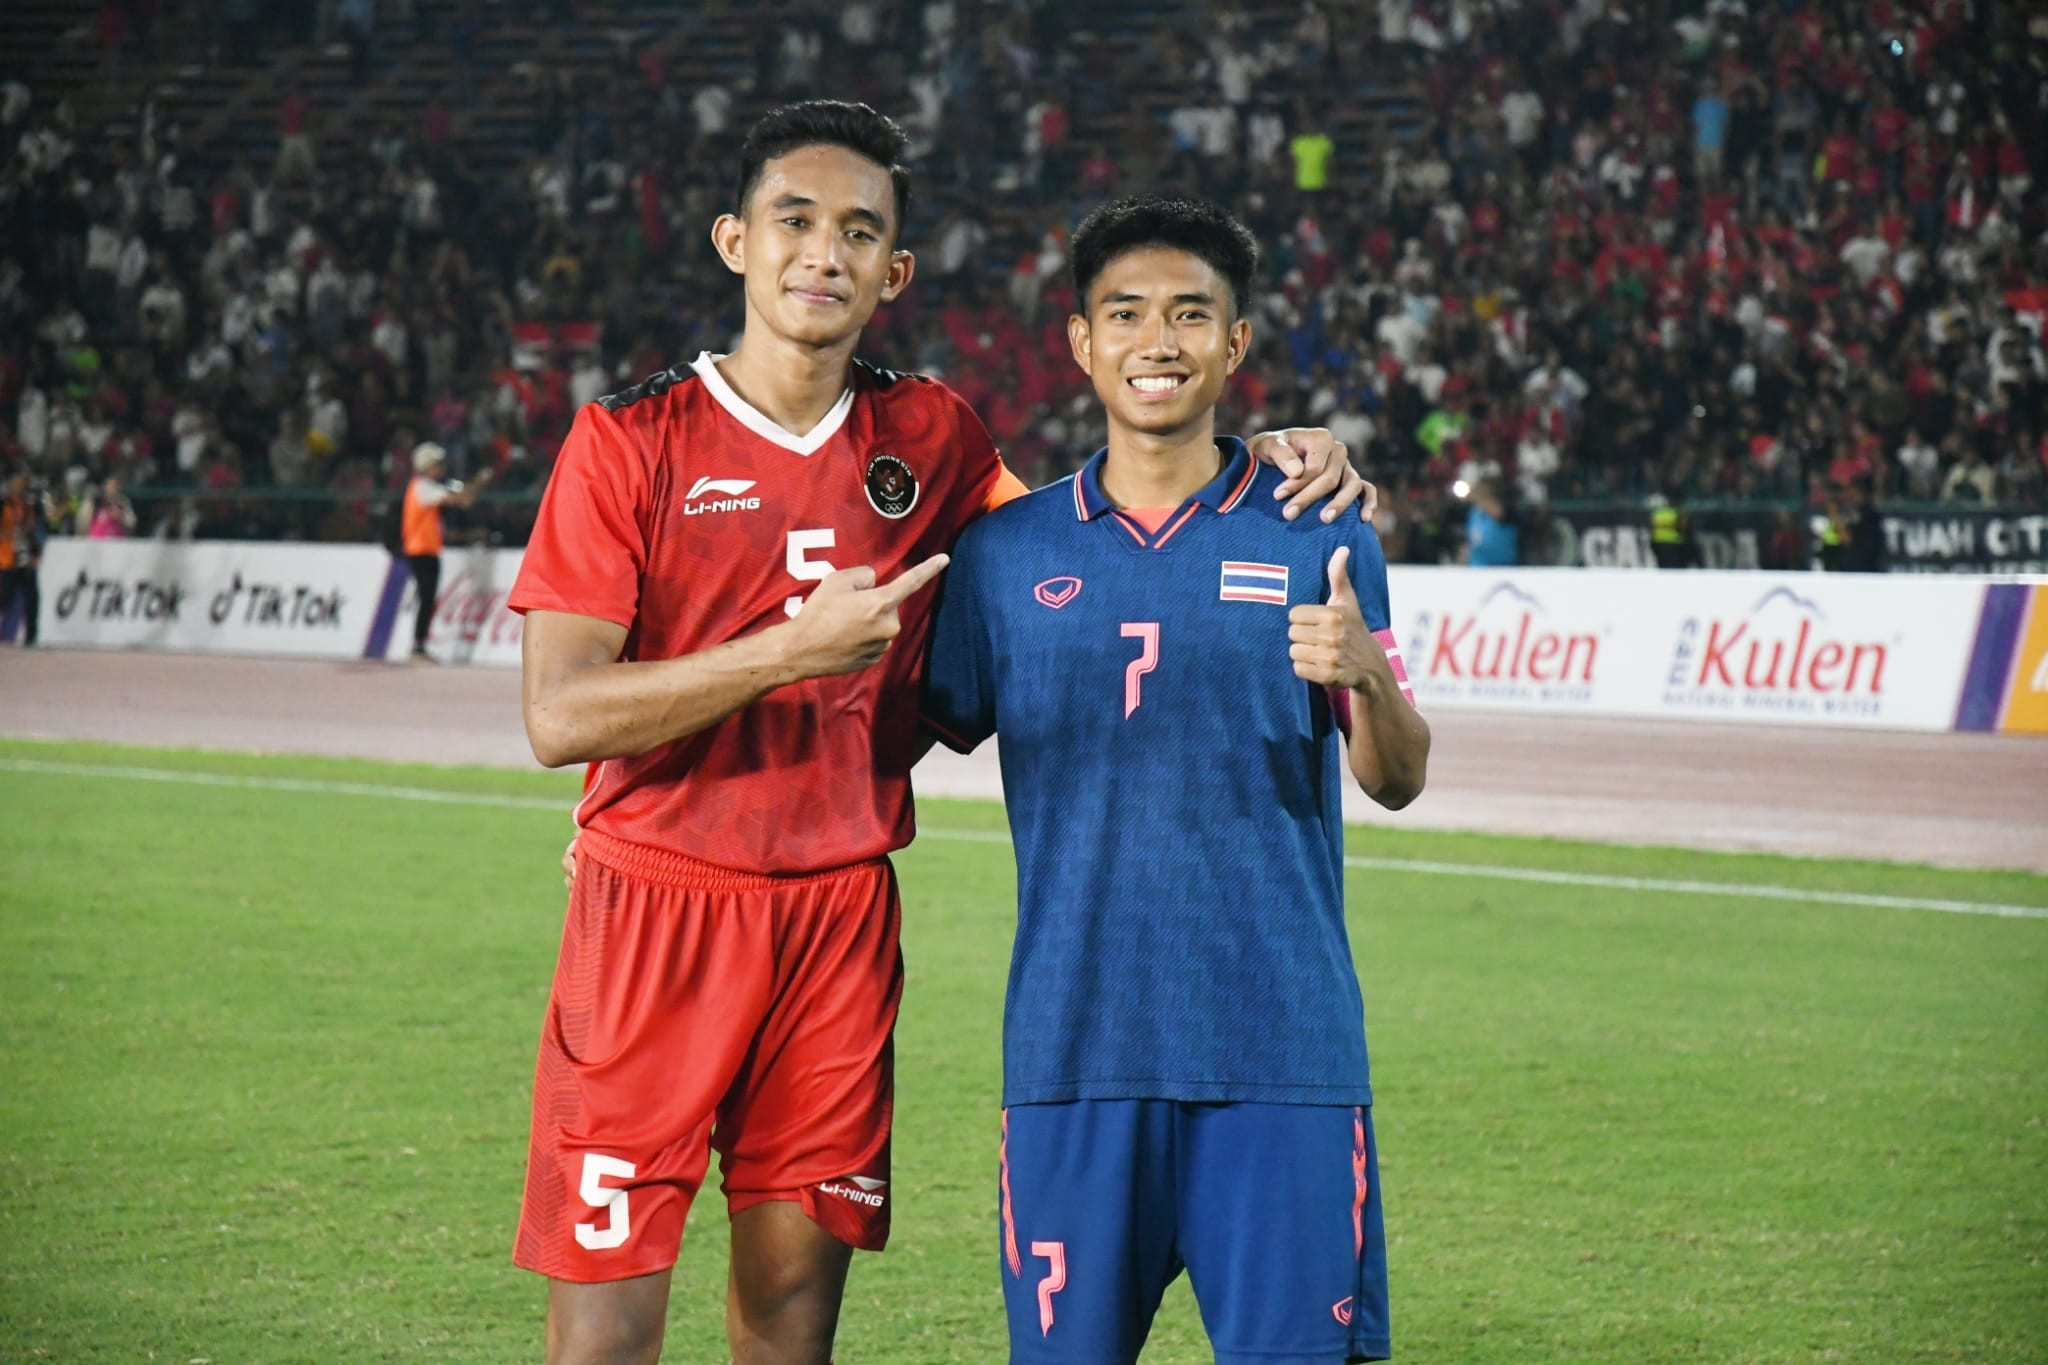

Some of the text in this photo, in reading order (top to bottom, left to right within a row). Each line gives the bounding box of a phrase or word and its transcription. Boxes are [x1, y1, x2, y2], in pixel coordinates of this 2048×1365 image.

[683, 497, 761, 515] LI-NING
[89, 579, 184, 623] TikTok
[245, 583, 344, 628] TikTok
[785, 529, 837, 619] 5
[1120, 622, 1160, 721] 7
[1429, 611, 1599, 683] Kulen
[1697, 617, 1888, 694] Kulen
[574, 1153, 637, 1251] 5
[820, 1182, 884, 1207] LI-NING
[1031, 1241, 1067, 1338] 7
